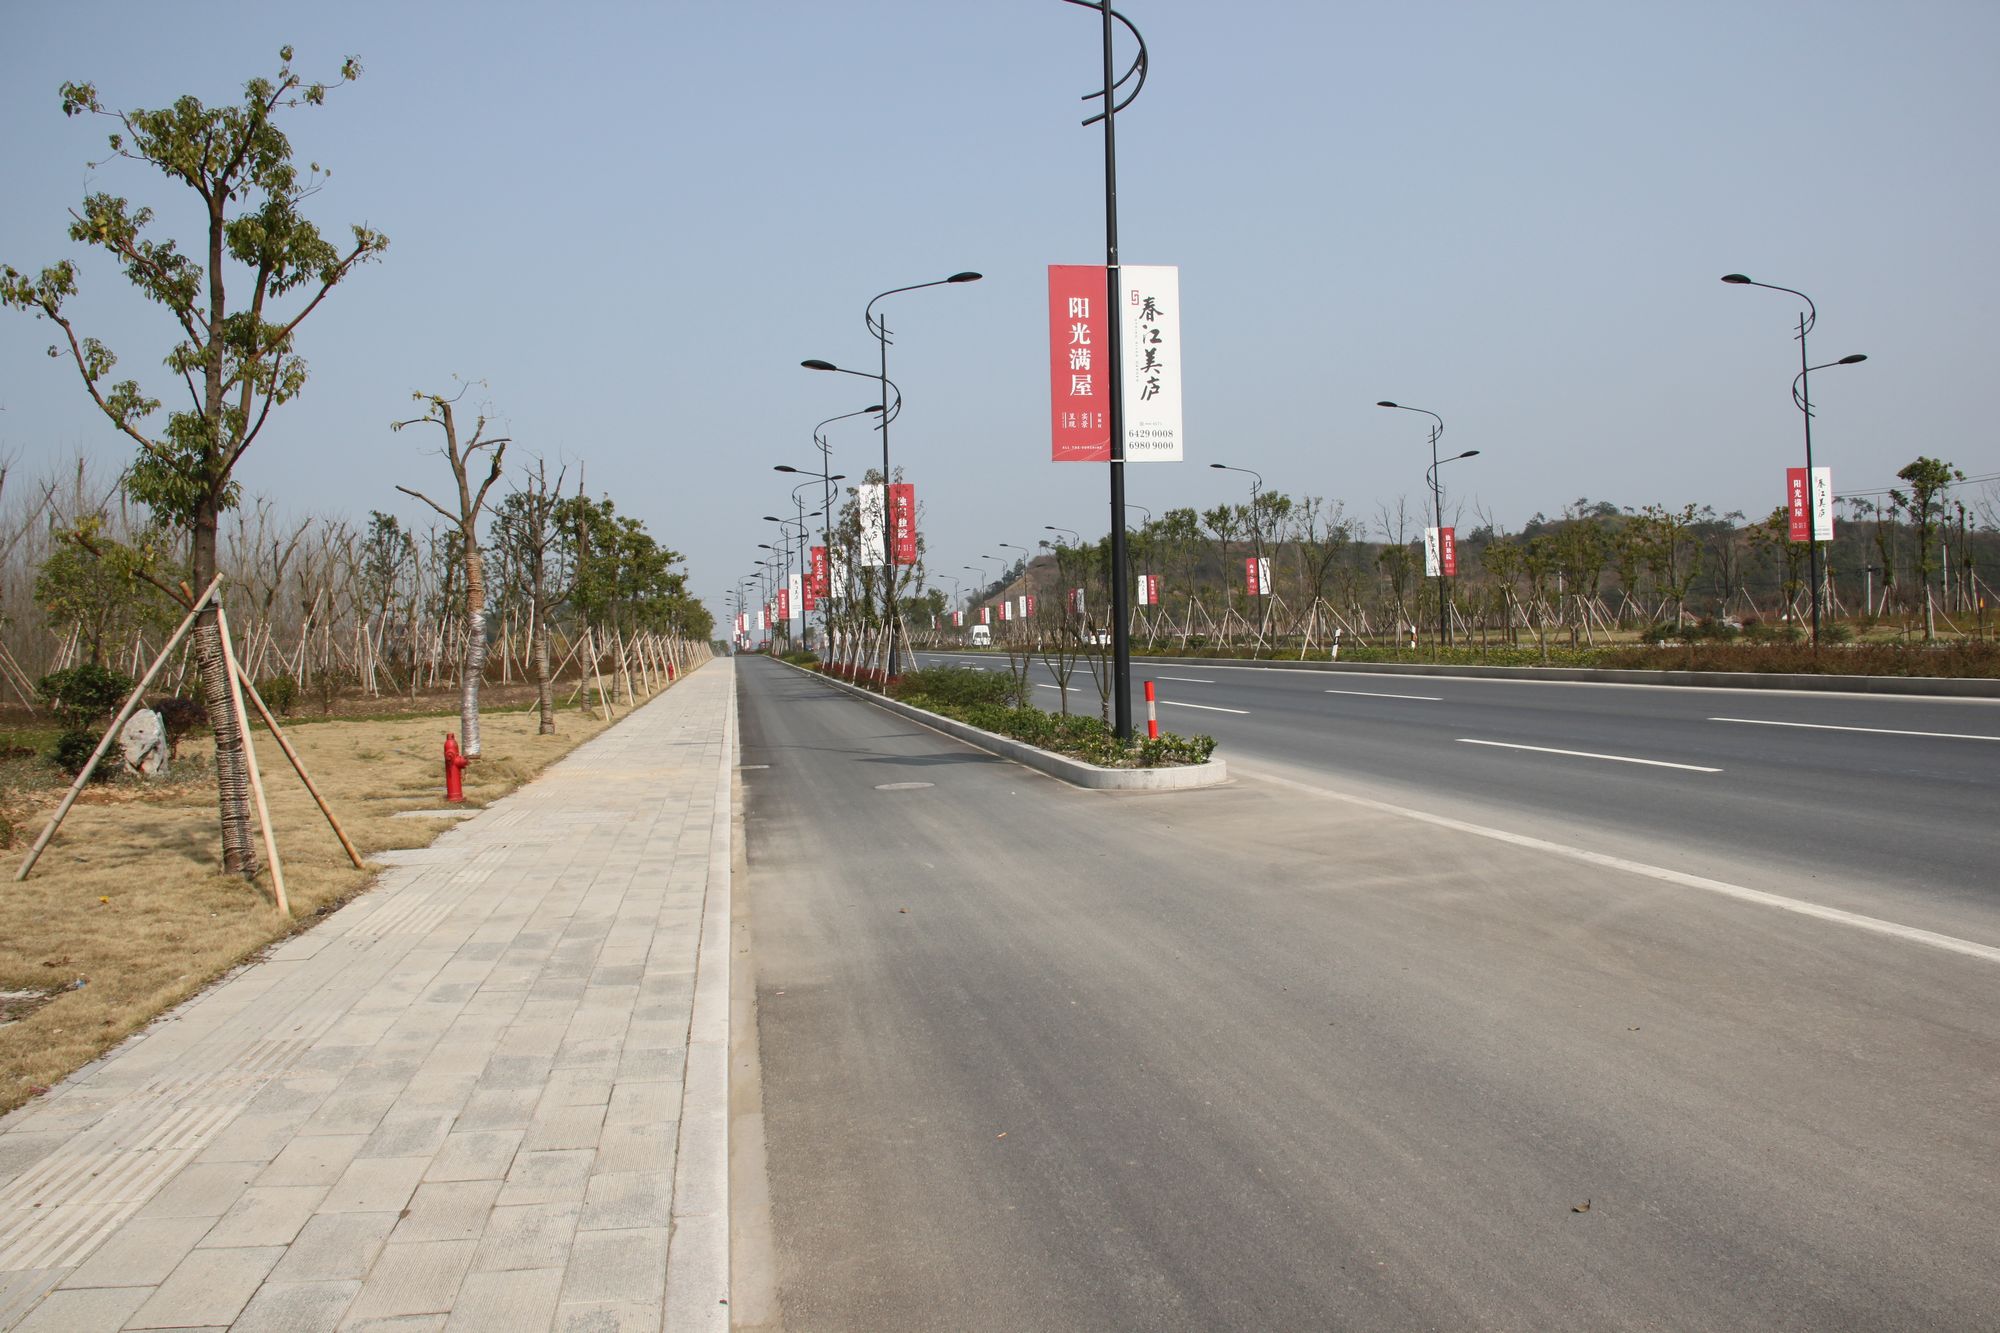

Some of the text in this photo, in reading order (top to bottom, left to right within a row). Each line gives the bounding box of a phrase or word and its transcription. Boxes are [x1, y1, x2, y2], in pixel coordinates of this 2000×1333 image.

[1068, 297, 1093, 396] 阳光满屋
[1138, 295, 1164, 401] 春江美庐
[1128, 429, 1174, 438] 6429 0008
[1129, 441, 1174, 450] 6980 9000
[1793, 479, 1803, 517] 阳光满屋
